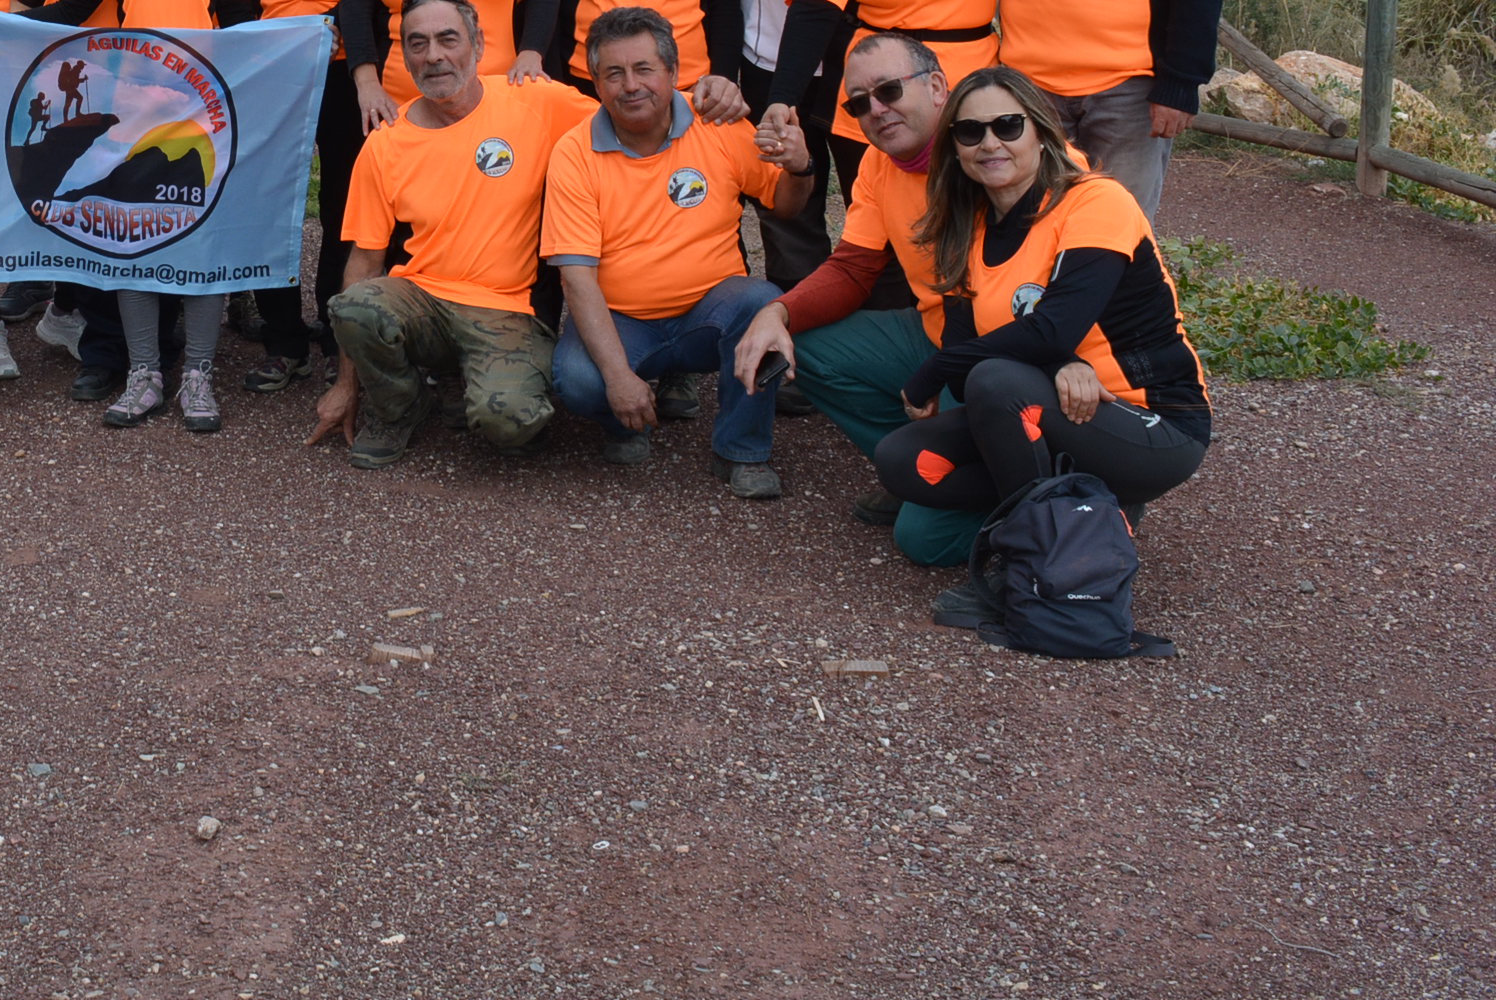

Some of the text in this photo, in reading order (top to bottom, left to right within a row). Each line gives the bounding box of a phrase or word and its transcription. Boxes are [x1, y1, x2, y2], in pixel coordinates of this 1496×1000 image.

[87, 35, 228, 135] ÁGUILAS EN MARCHA
[155, 184, 202, 203] 2018
[30, 199, 197, 243] CLUB SENDERISTA
